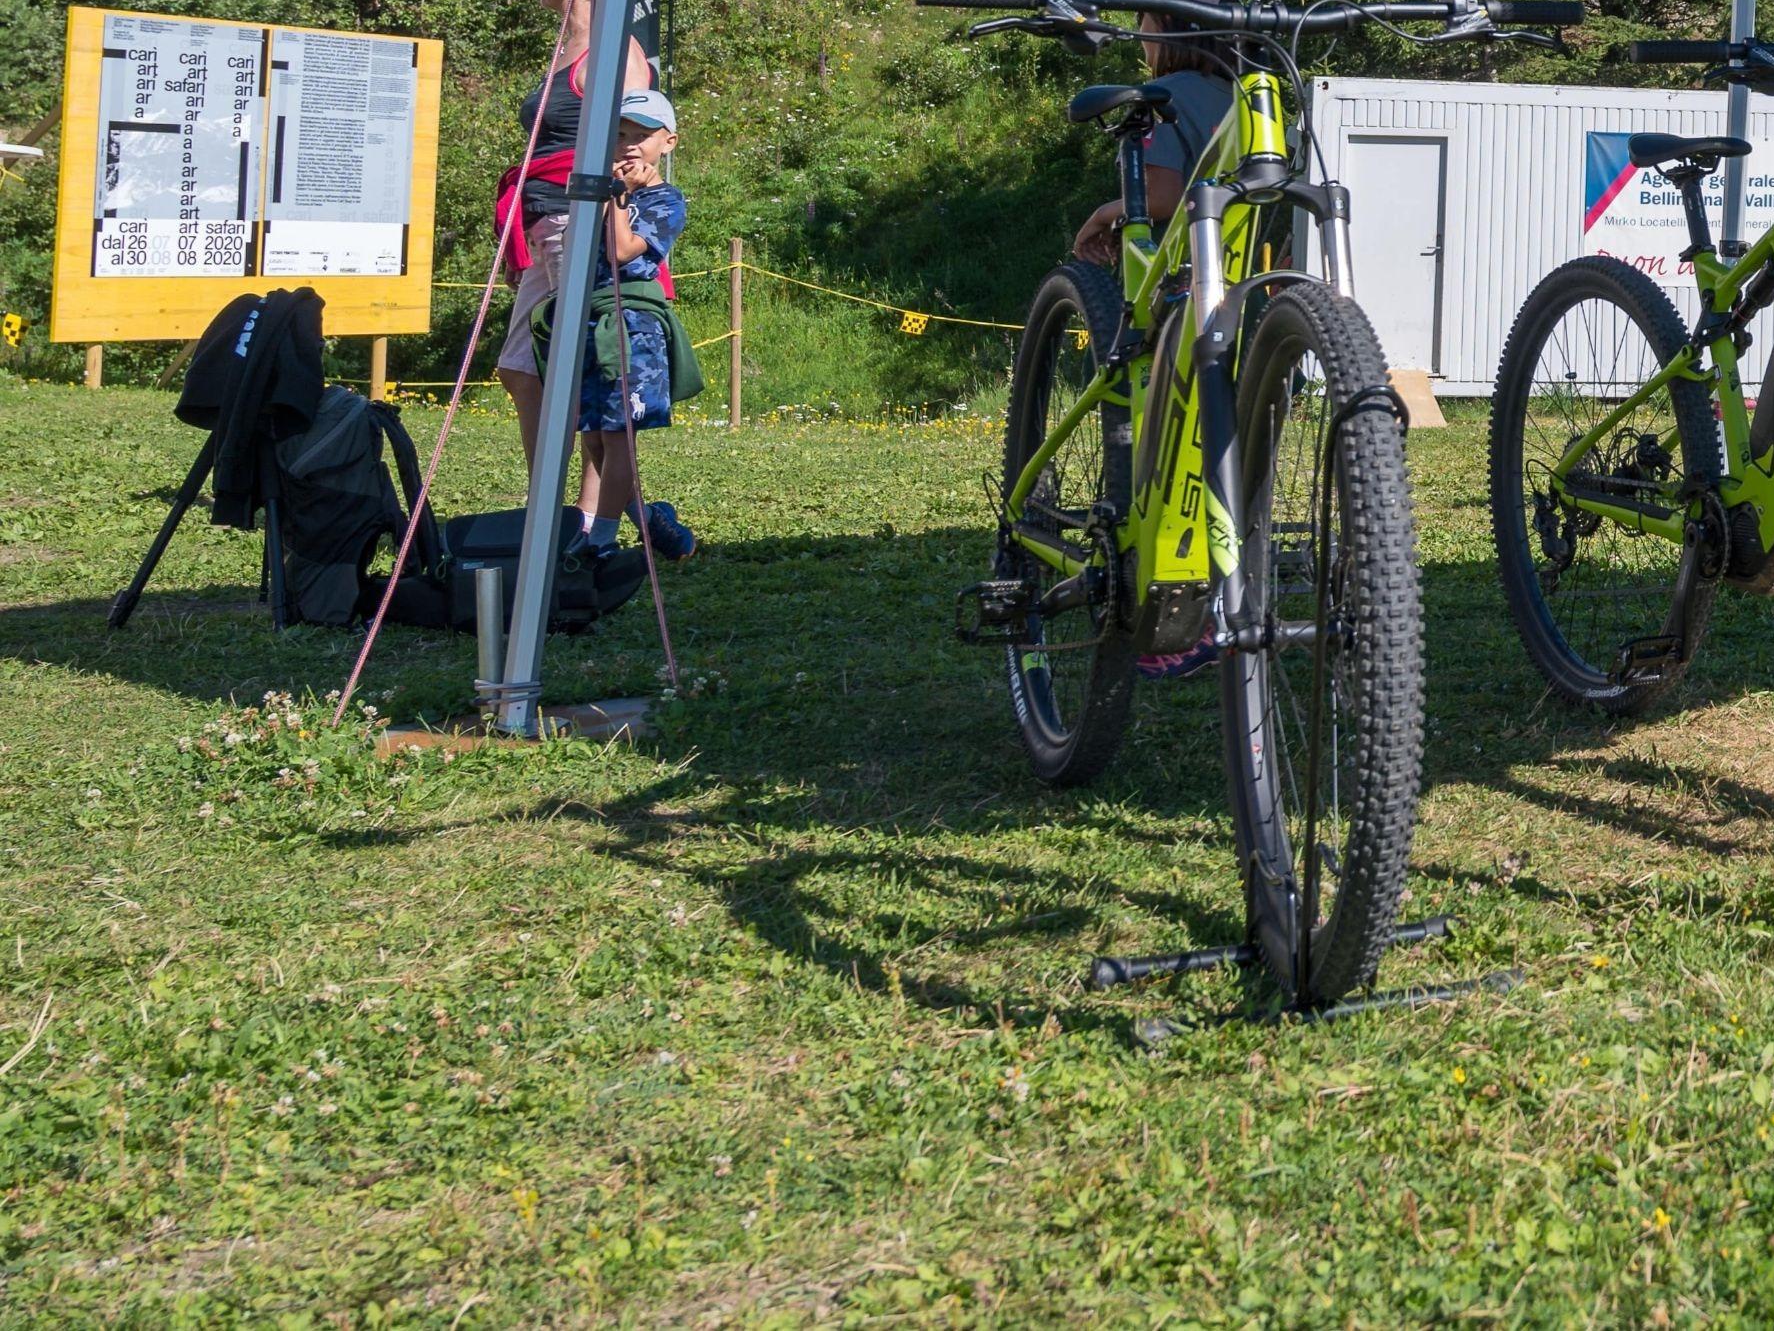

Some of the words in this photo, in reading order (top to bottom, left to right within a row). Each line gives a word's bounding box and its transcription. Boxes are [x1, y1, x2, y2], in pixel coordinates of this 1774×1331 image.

[164, 78, 206, 94] safari
[135, 93, 152, 104] ar
[234, 98, 249, 110] ar
[134, 107, 144, 118] a
[185, 110, 201, 121] ar
[233, 112, 242, 123] a
[183, 124, 193, 135] a
[232, 126, 241, 137] a
[183, 138, 192, 149] a
[182, 152, 192, 163] a
[182, 166, 197, 177] ar
[181, 180, 197, 191] ar
[180, 194, 196, 205] ar
[1640, 191, 1723, 207] Bellinna
[179, 206, 200, 219] art
[179, 221, 199, 234] art
[205, 220, 245, 234] safari
[1604, 216, 1637, 227] Mirko
[1640, 217, 1686, 228] Locatelli
[102, 235, 125, 249] dal
[128, 235, 148, 250] 26
[178, 236, 197, 250] 07
[204, 236, 243, 250] 2020
[111, 250, 124, 265] al
[127, 250, 147, 265] 30
[177, 251, 197, 265] 08
[203, 251, 242, 266] 2020
